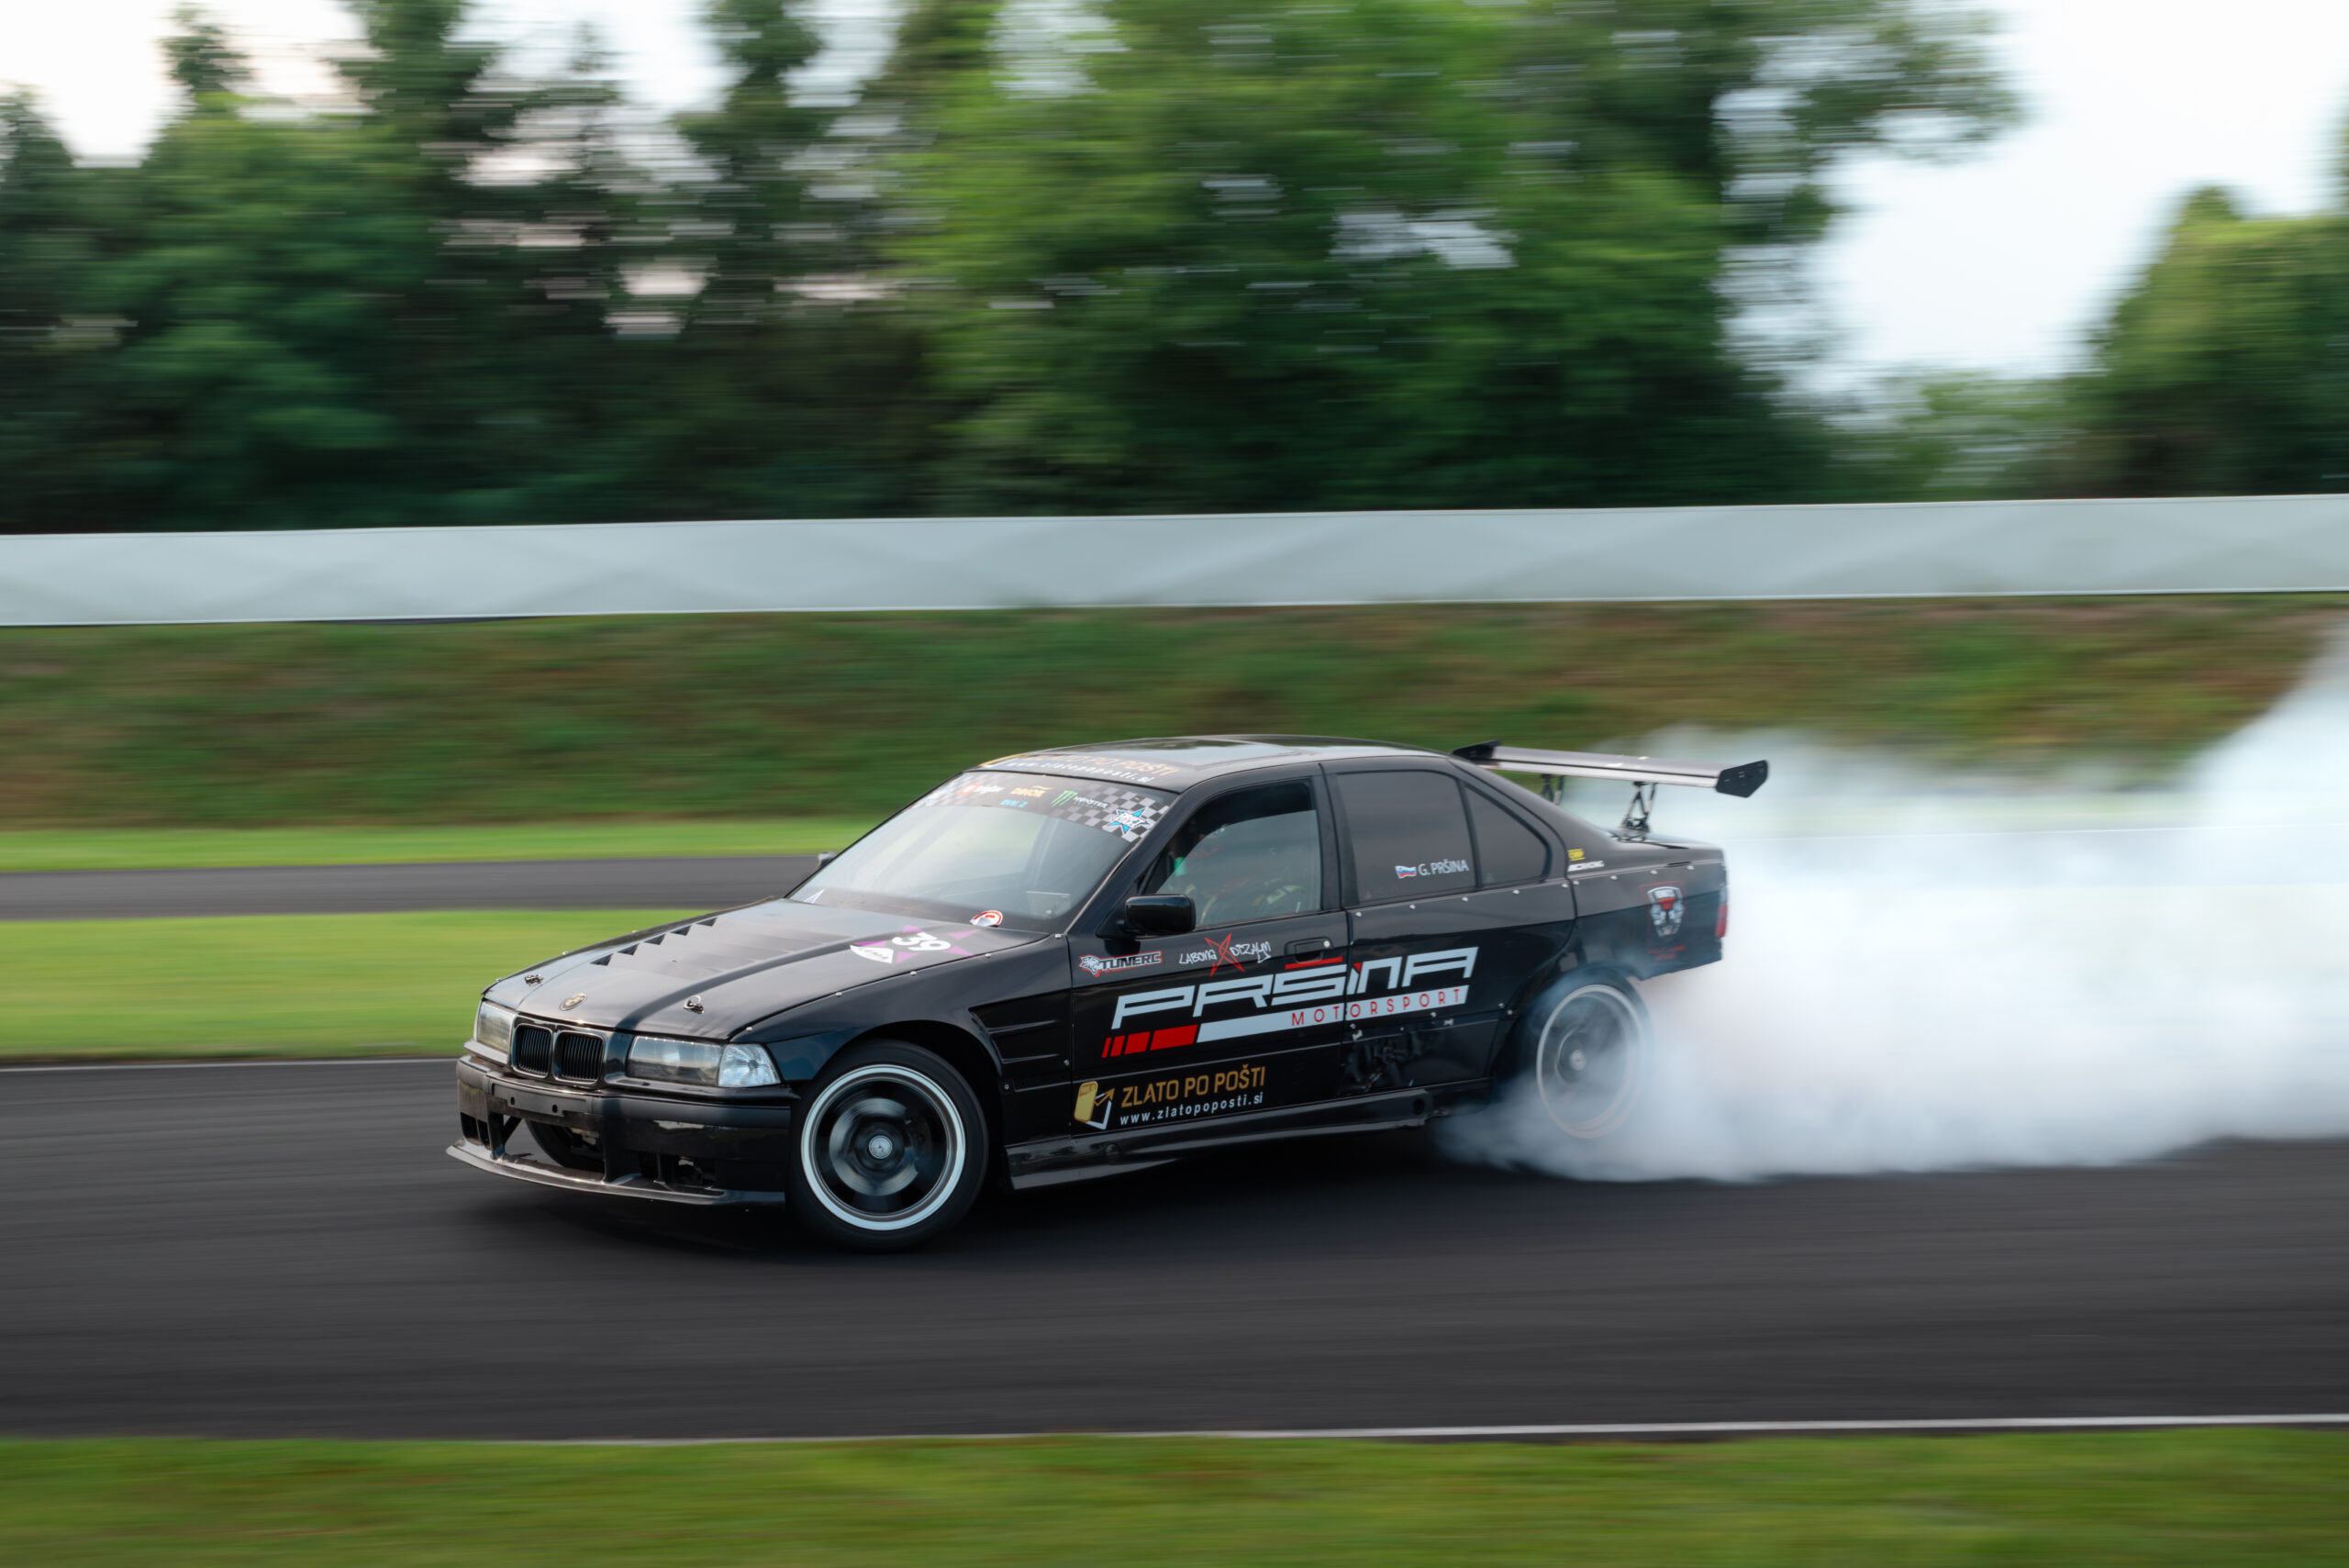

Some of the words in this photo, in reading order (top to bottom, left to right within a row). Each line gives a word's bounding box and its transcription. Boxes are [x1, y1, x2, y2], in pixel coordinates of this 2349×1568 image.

[1418, 862, 1431, 876] G.
[1431, 859, 1469, 874] PRŠINA
[892, 932, 952, 951] 39
[1100, 951, 1161, 972] TUNERC
[1179, 949, 1218, 964] LABONG
[1291, 988, 1461, 1027] MOTORSPORT
[1121, 1079, 1179, 1108] ZLATO
[1184, 1074, 1209, 1098] PO
[1214, 1064, 1266, 1093] POŠTI
[1119, 1092, 1264, 1126] www.zlatopoposti.si
